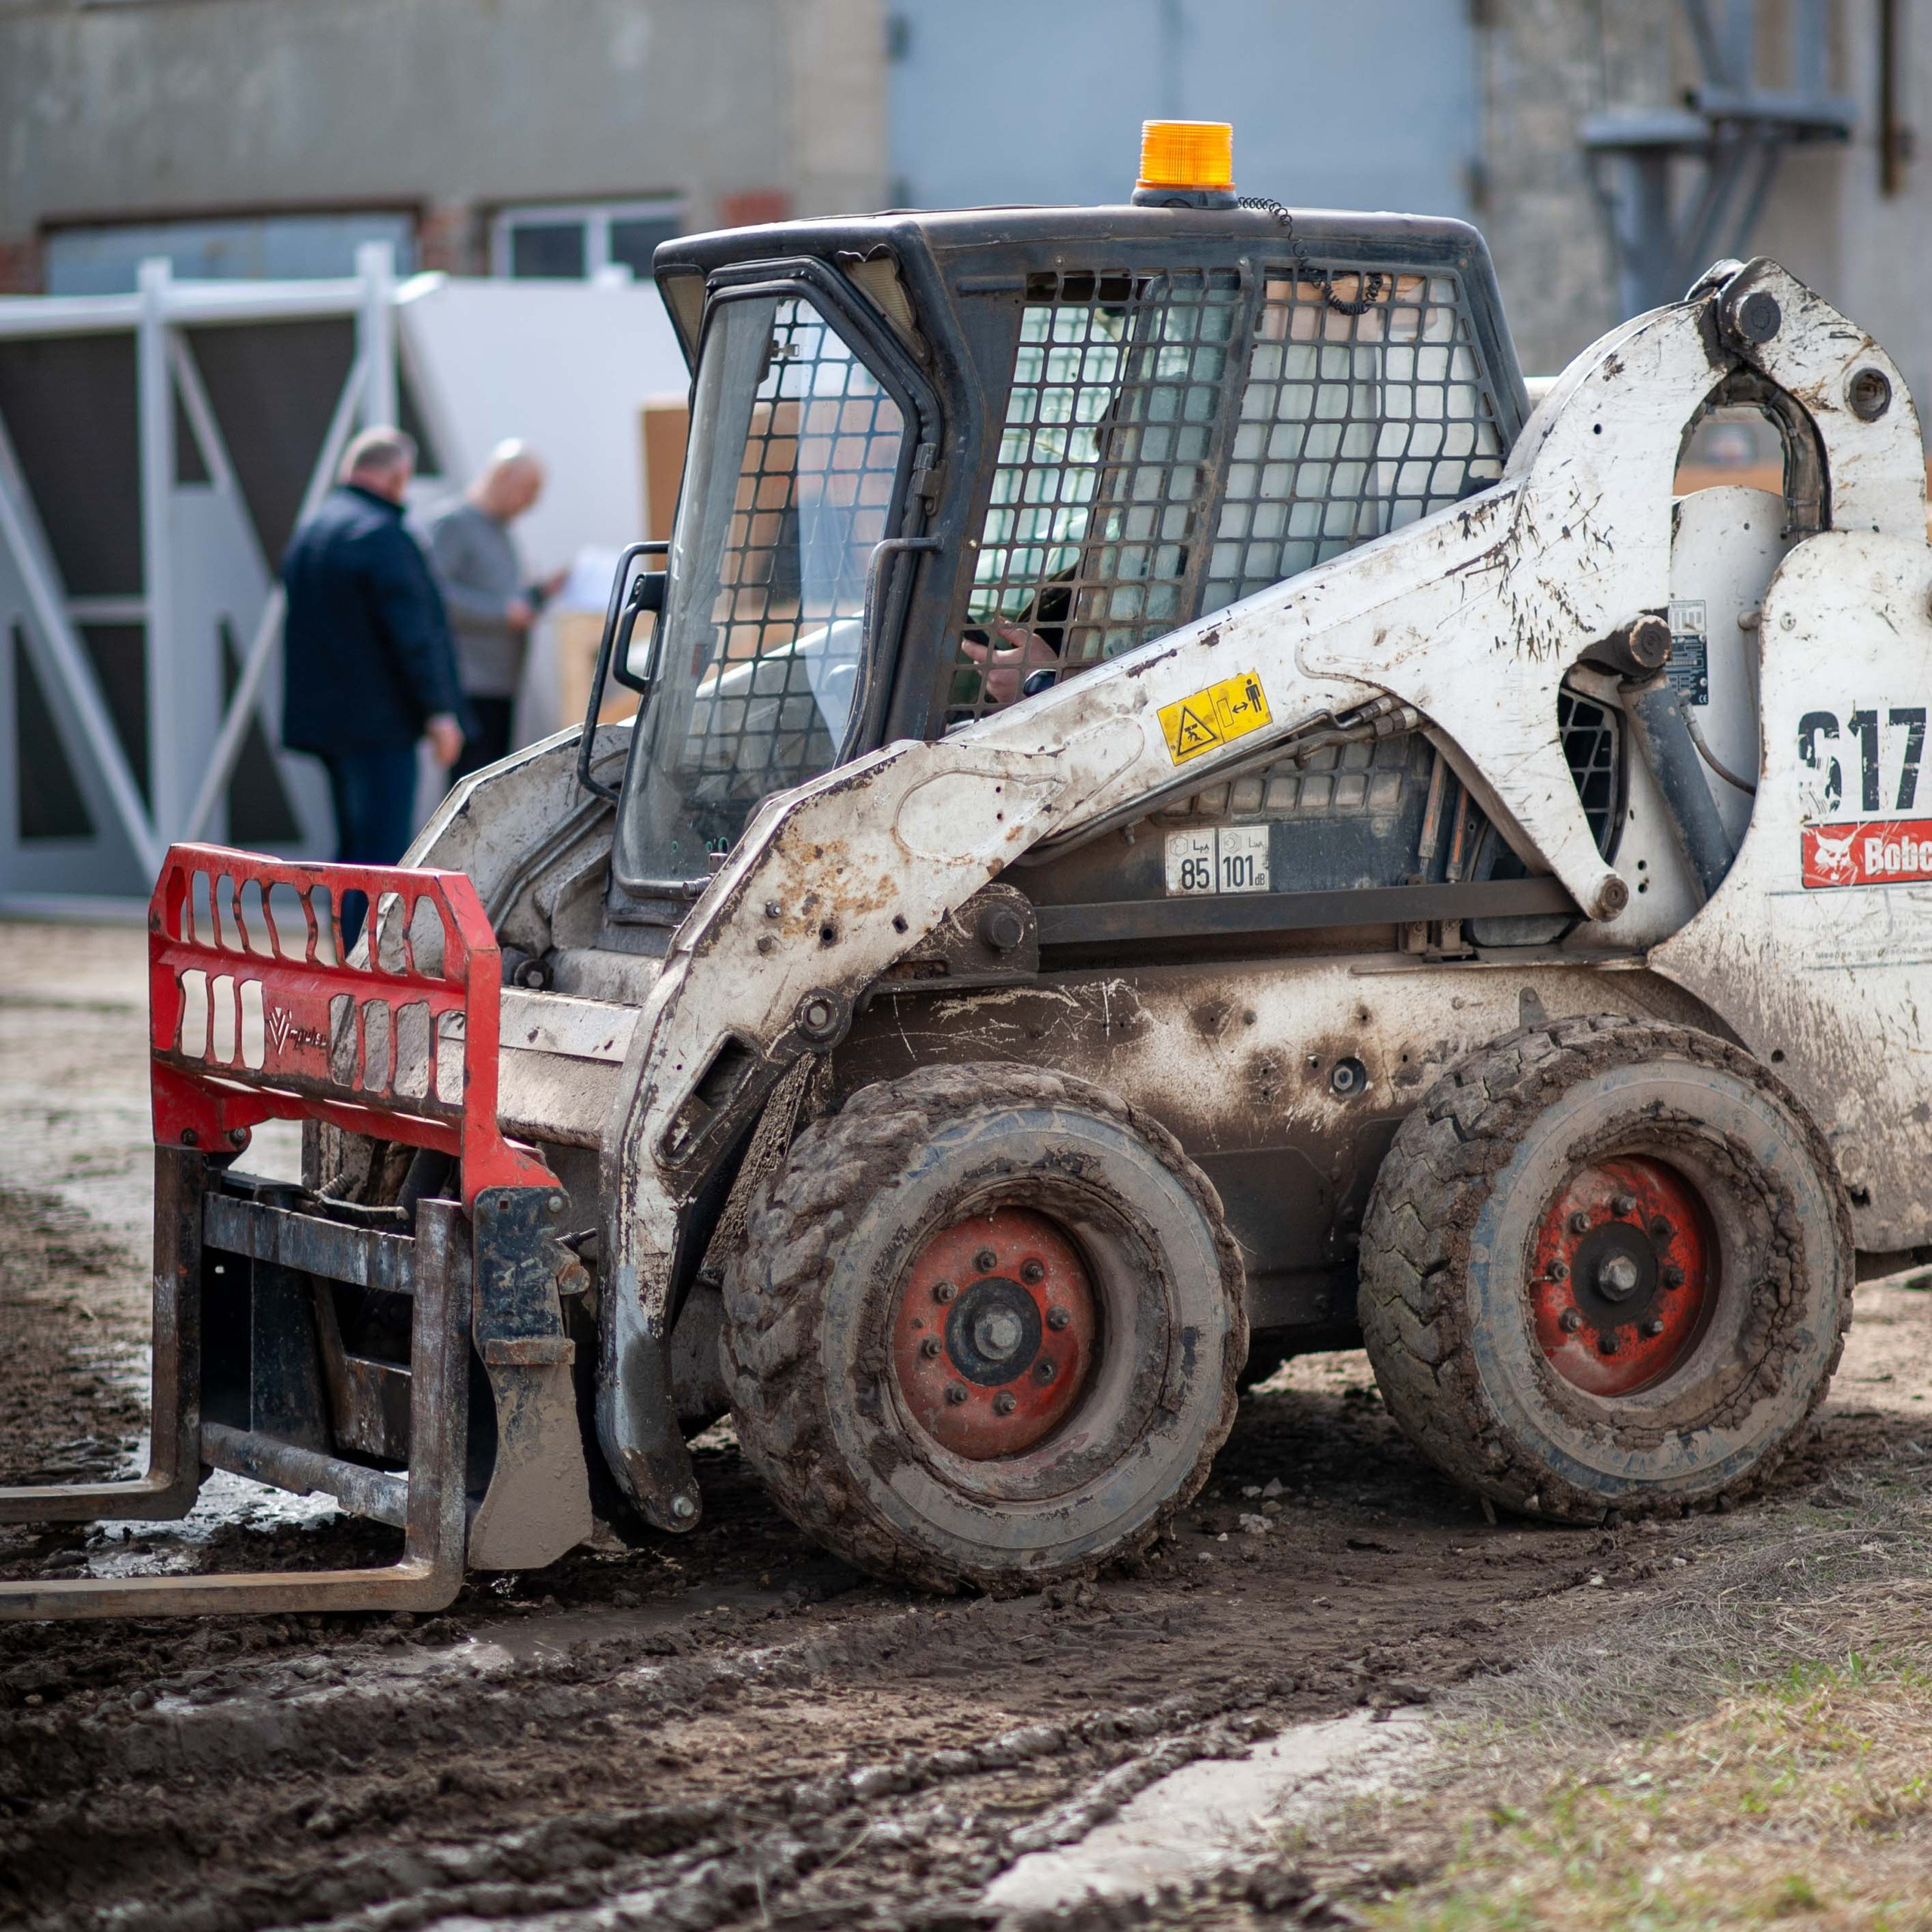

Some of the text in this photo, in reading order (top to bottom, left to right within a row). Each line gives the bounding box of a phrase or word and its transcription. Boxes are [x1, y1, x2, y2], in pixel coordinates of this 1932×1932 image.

[1181, 857, 1210, 890] 85
[1223, 854, 1266, 888] 101 dB
